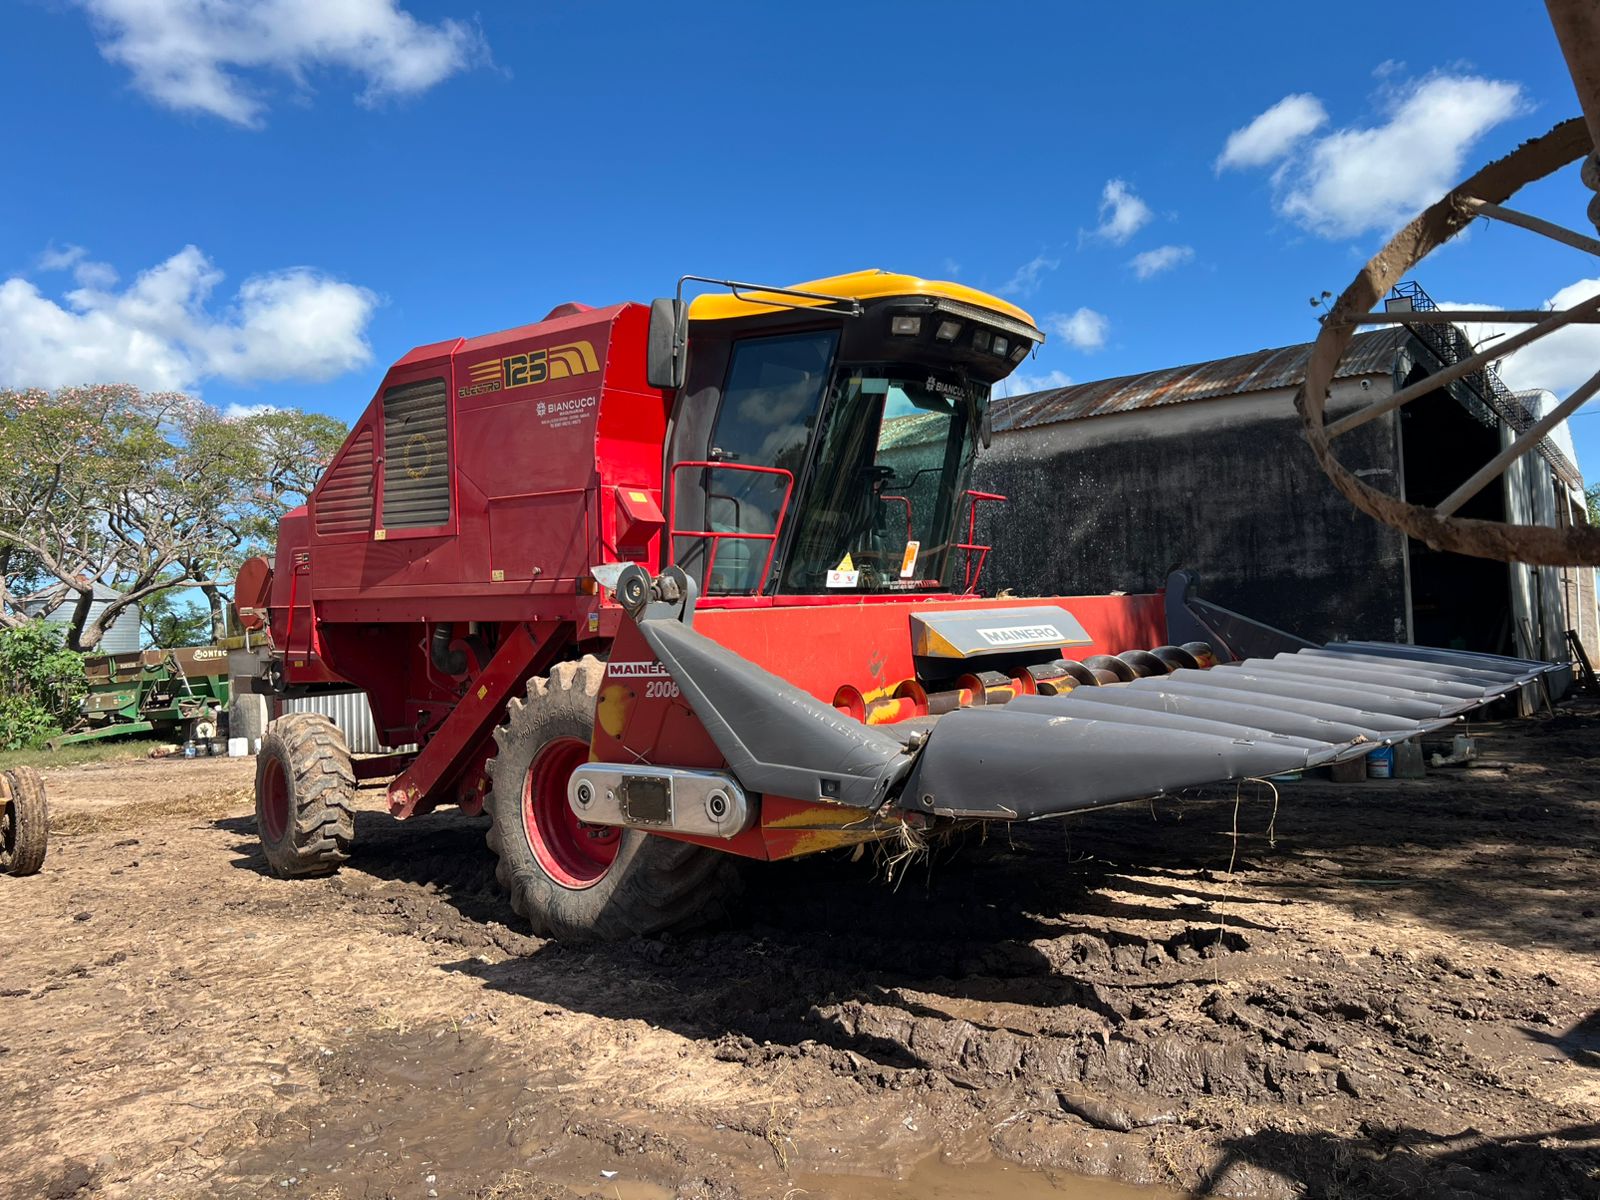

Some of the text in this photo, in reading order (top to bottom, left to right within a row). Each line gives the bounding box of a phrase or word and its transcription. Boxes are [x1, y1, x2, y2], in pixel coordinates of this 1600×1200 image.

[458, 349, 548, 398] ELECTRO 125
[547, 396, 596, 413] BIANCUCCI
[983, 627, 1058, 642] MAINERO
